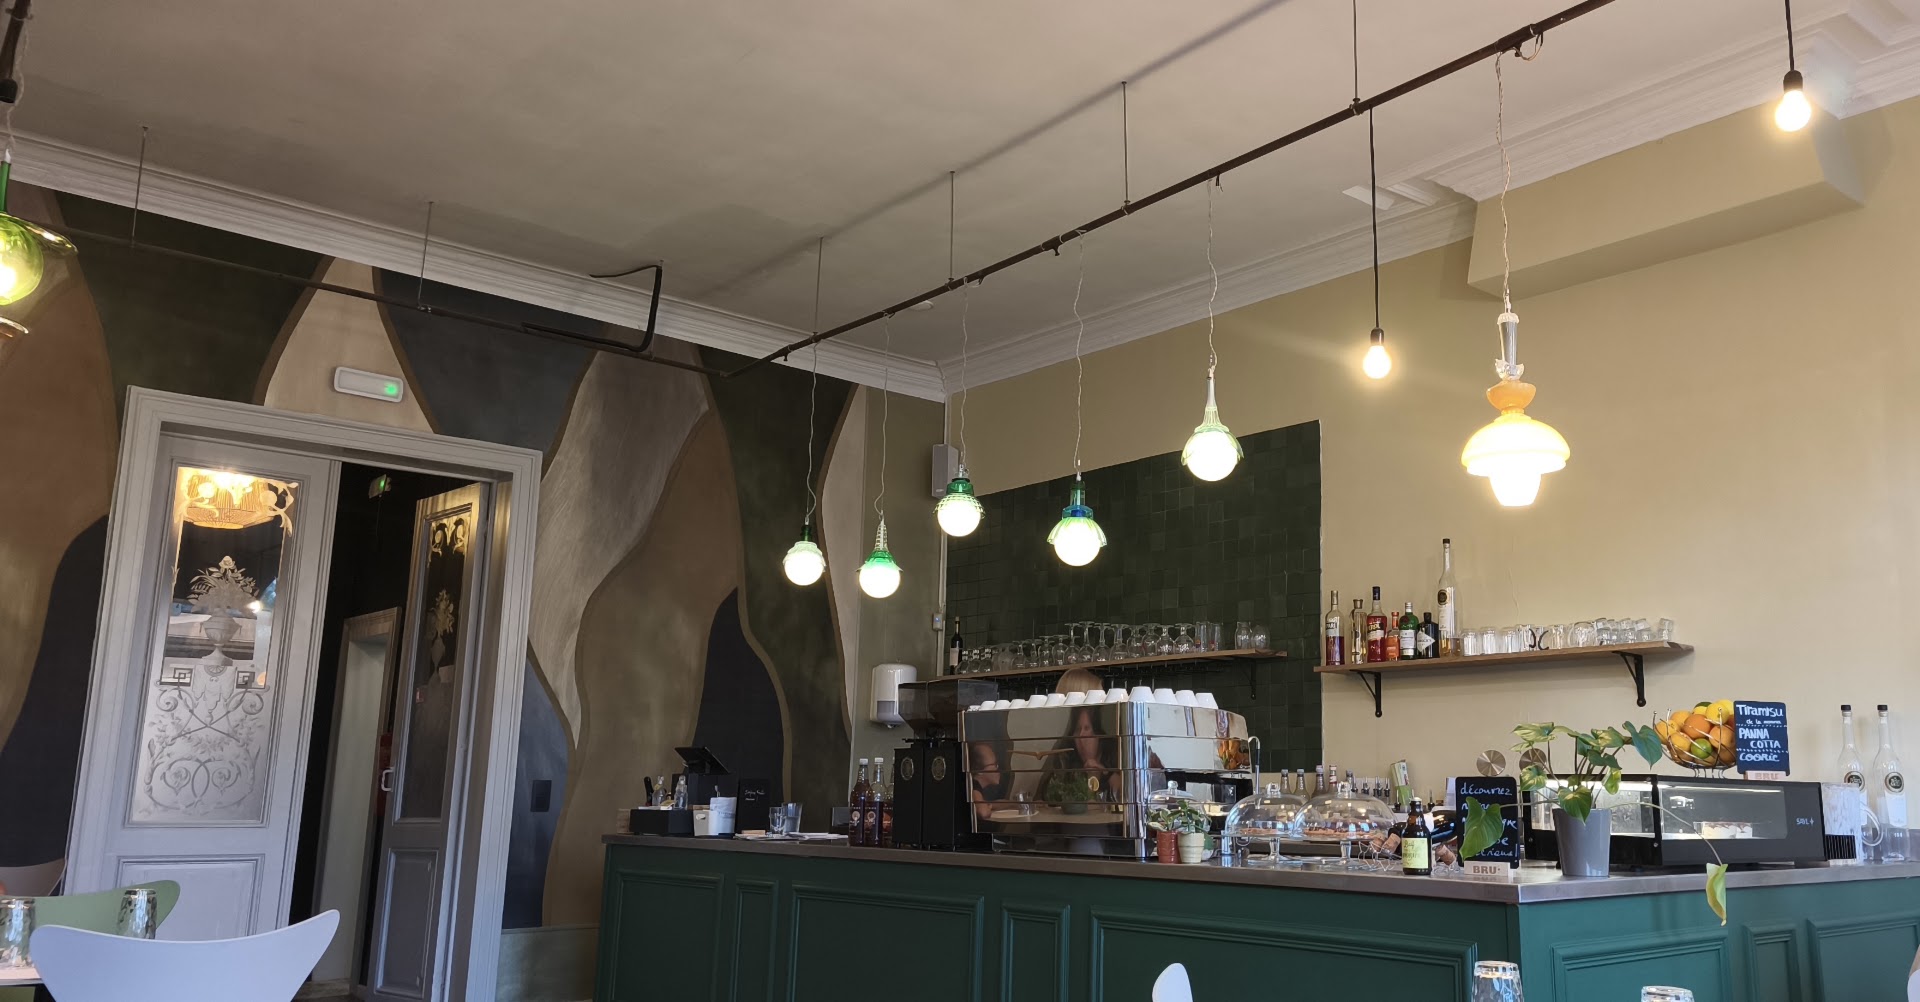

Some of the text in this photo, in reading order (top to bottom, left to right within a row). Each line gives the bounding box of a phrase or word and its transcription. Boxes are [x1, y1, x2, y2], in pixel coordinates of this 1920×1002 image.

[1735, 704, 1784, 718] Tiramisu
[1738, 727, 1770, 740] PANNA
[1750, 740, 1781, 749] COTTA
[1460, 782, 1512, 796] découvrez
